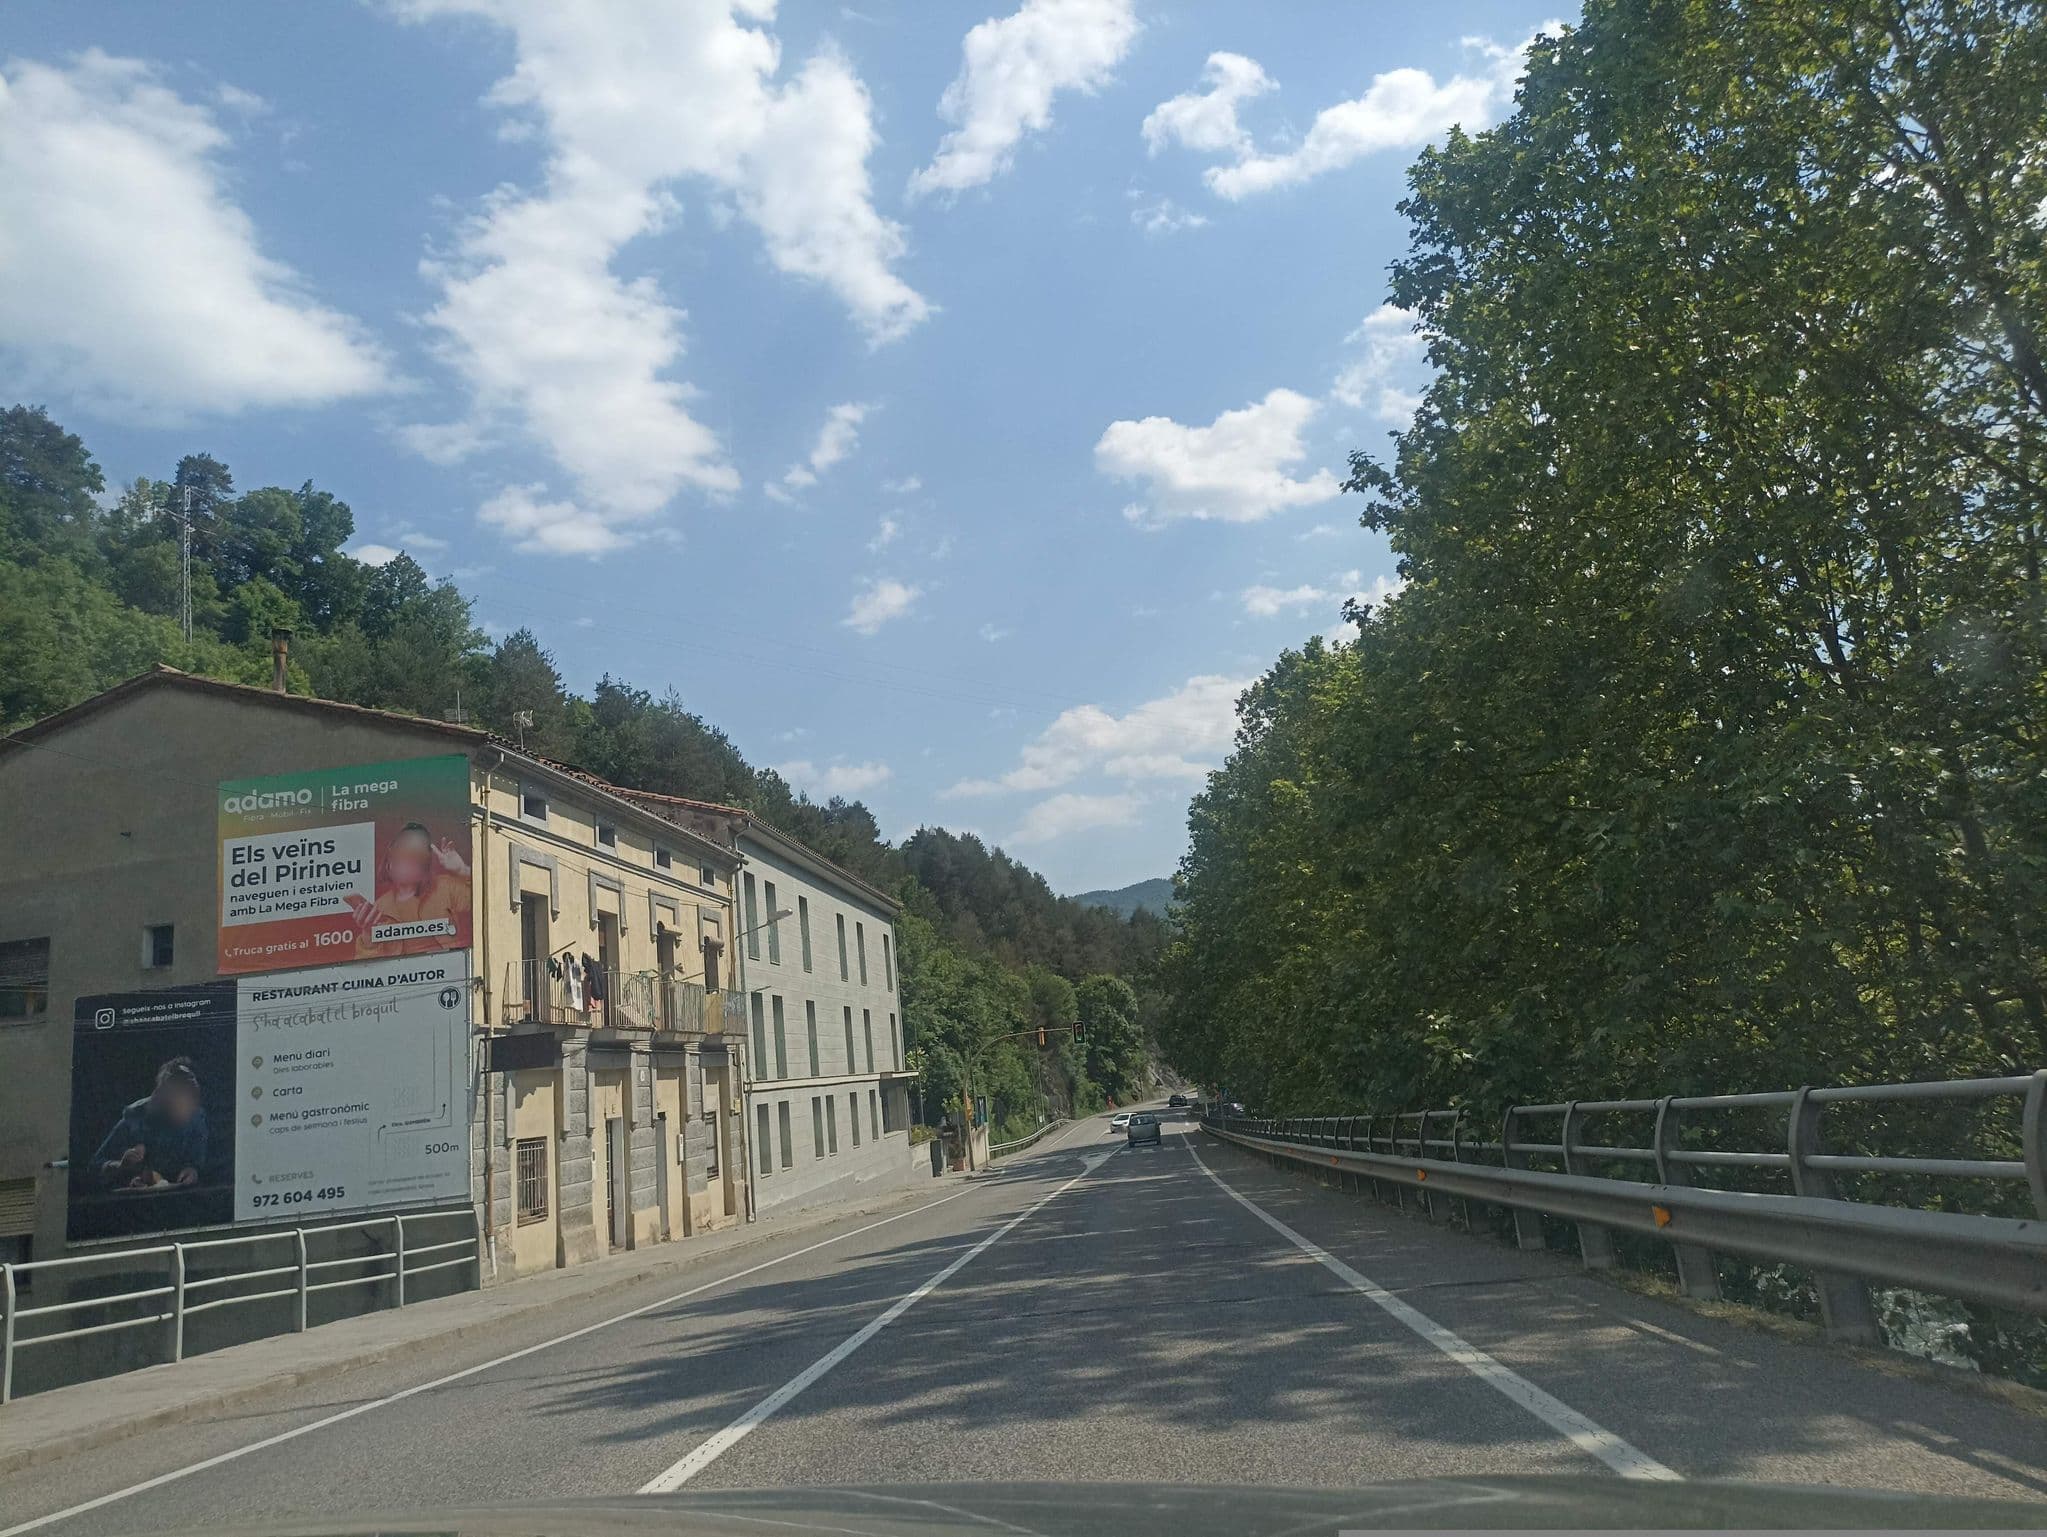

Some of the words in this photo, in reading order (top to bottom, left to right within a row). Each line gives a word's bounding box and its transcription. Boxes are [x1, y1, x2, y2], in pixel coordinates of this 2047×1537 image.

[332, 784, 350, 797] La
[354, 780, 398, 794] mega
[224, 788, 313, 815] adamo
[331, 799, 368, 812] fibra
[232, 845, 266, 865] Els
[272, 838, 336, 860] veïns
[231, 866, 267, 888] del
[276, 859, 361, 882] Pirineu
[230, 889, 289, 903] naveguen
[293, 885, 296, 896] i
[300, 881, 354, 895] estalvien
[230, 906, 256, 917] amb
[259, 904, 272, 914] La
[275, 901, 308, 912] Mega
[310, 896, 339, 908] Fibra
[314, 930, 353, 947] 1600
[375, 921, 444, 939] adamo.es
[233, 945, 263, 957] Truca
[266, 941, 297, 955] gratis
[299, 939, 309, 949] al
[253, 982, 339, 1002] RESTAURANT
[343, 978, 385, 991] CUINA
[388, 969, 445, 985] D'AUTOR
[305, 1048, 330, 1060] diari
[291, 1123, 301, 1132] de
[424, 1142, 460, 1155] 500m
[269, 1171, 314, 1183] RESERVES
[253, 1193, 280, 1207] 972
[283, 1190, 312, 1204] 604
[317, 1186, 345, 1200] 495
